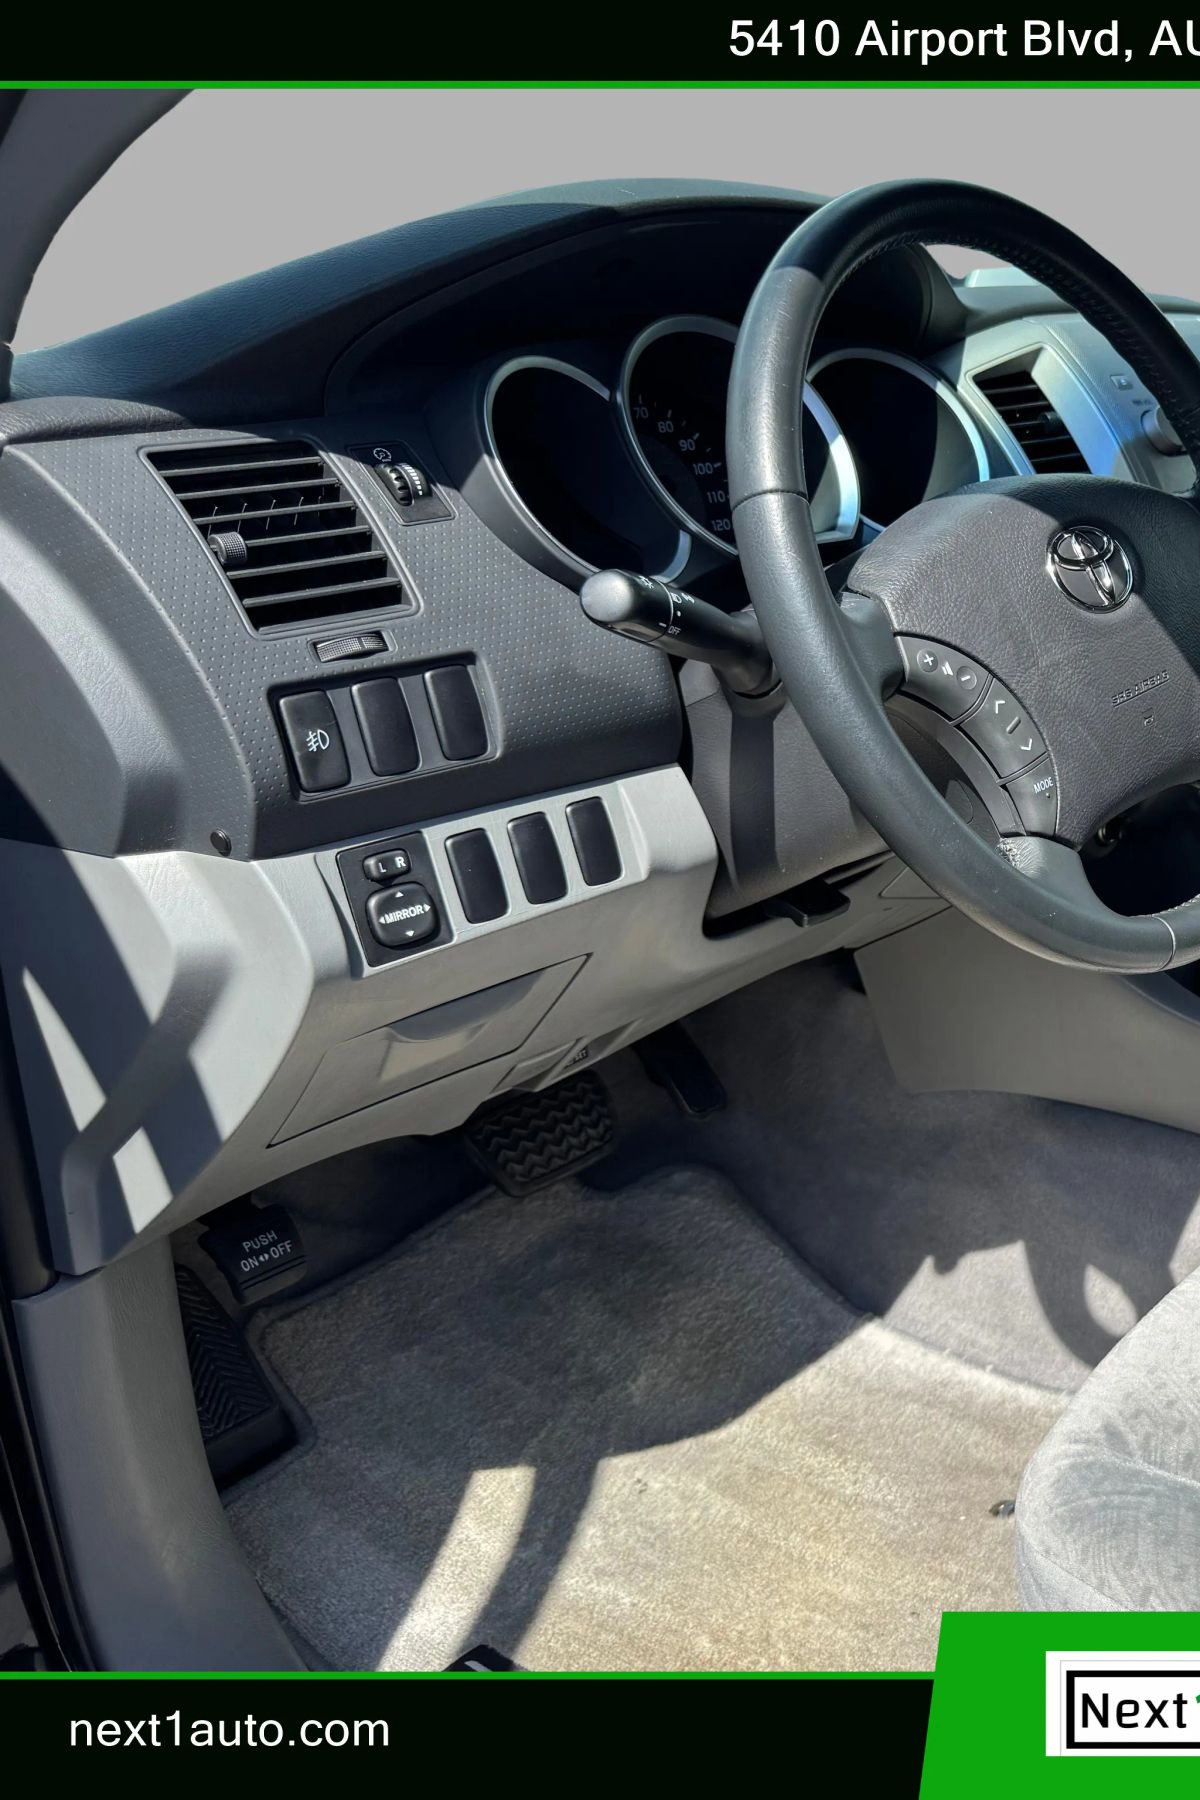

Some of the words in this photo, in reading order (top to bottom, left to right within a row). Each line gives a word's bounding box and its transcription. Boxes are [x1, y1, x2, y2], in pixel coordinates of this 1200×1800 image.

[657, 420, 674, 433] 80
[679, 439, 696, 452] 90
[692, 462, 714, 475] 100
[706, 490, 726, 504] 110
[711, 518, 732, 531] 120
[1033, 776, 1054, 794] MODE
[378, 862, 388, 873] L
[394, 856, 407, 868] R
[384, 904, 425, 924] MIRROR
[242, 1230, 278, 1253] PUSH
